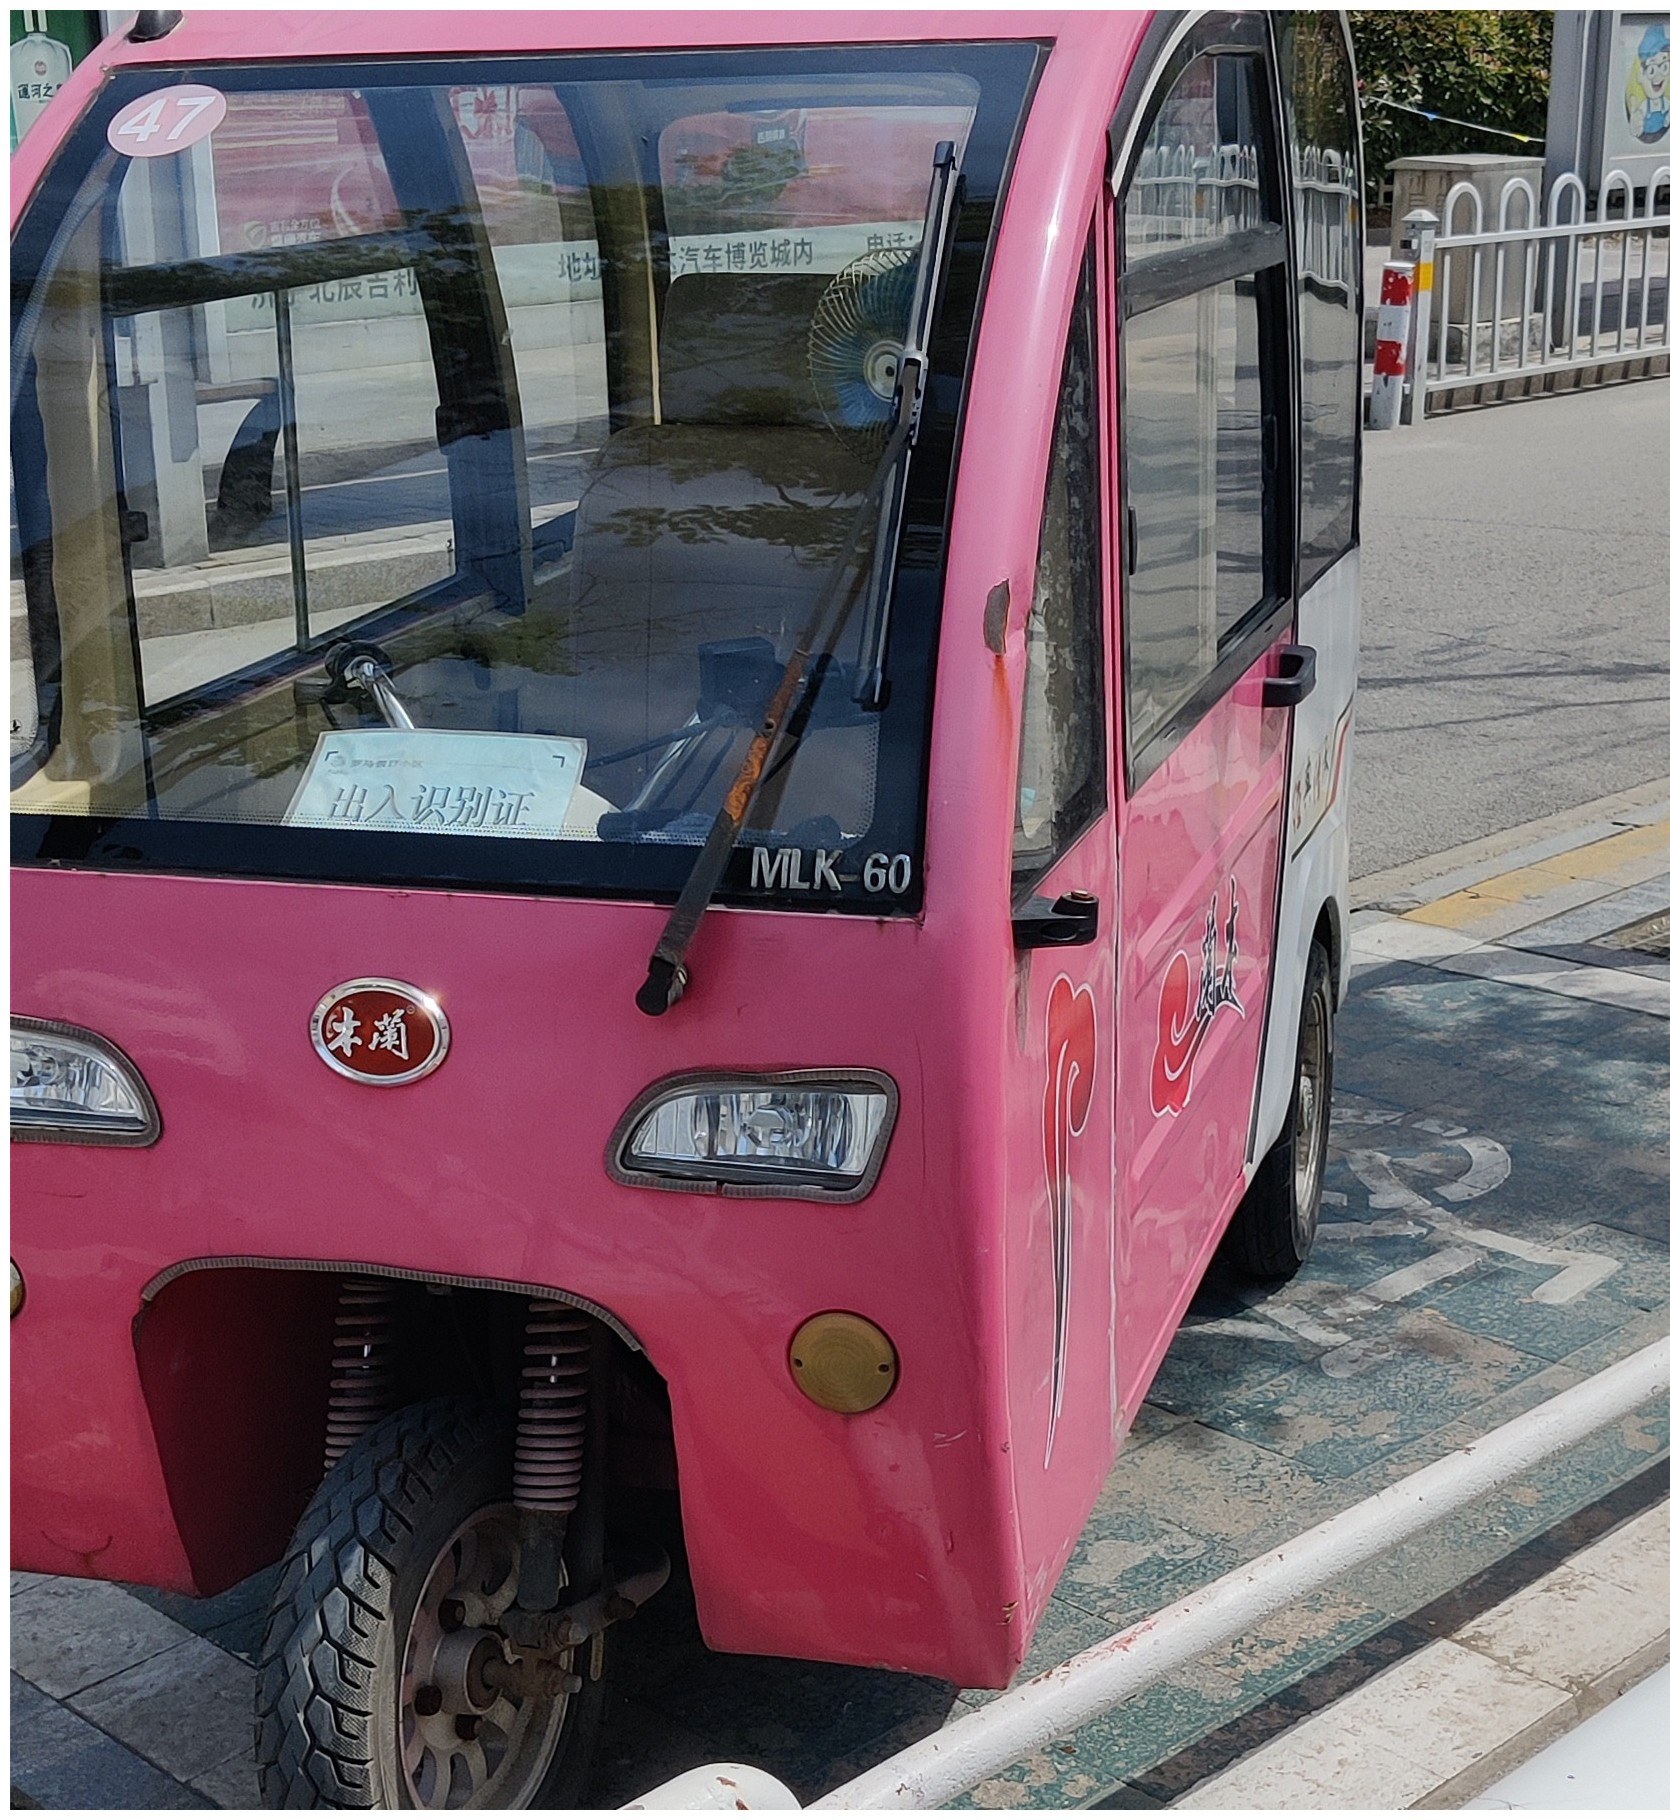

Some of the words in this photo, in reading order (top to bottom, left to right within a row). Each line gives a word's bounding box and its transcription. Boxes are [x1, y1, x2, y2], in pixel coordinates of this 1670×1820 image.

[118, 96, 215, 142] 47
[251, 268, 417, 309] 北辰吉利
[330, 783, 535, 828] 出入识别证
